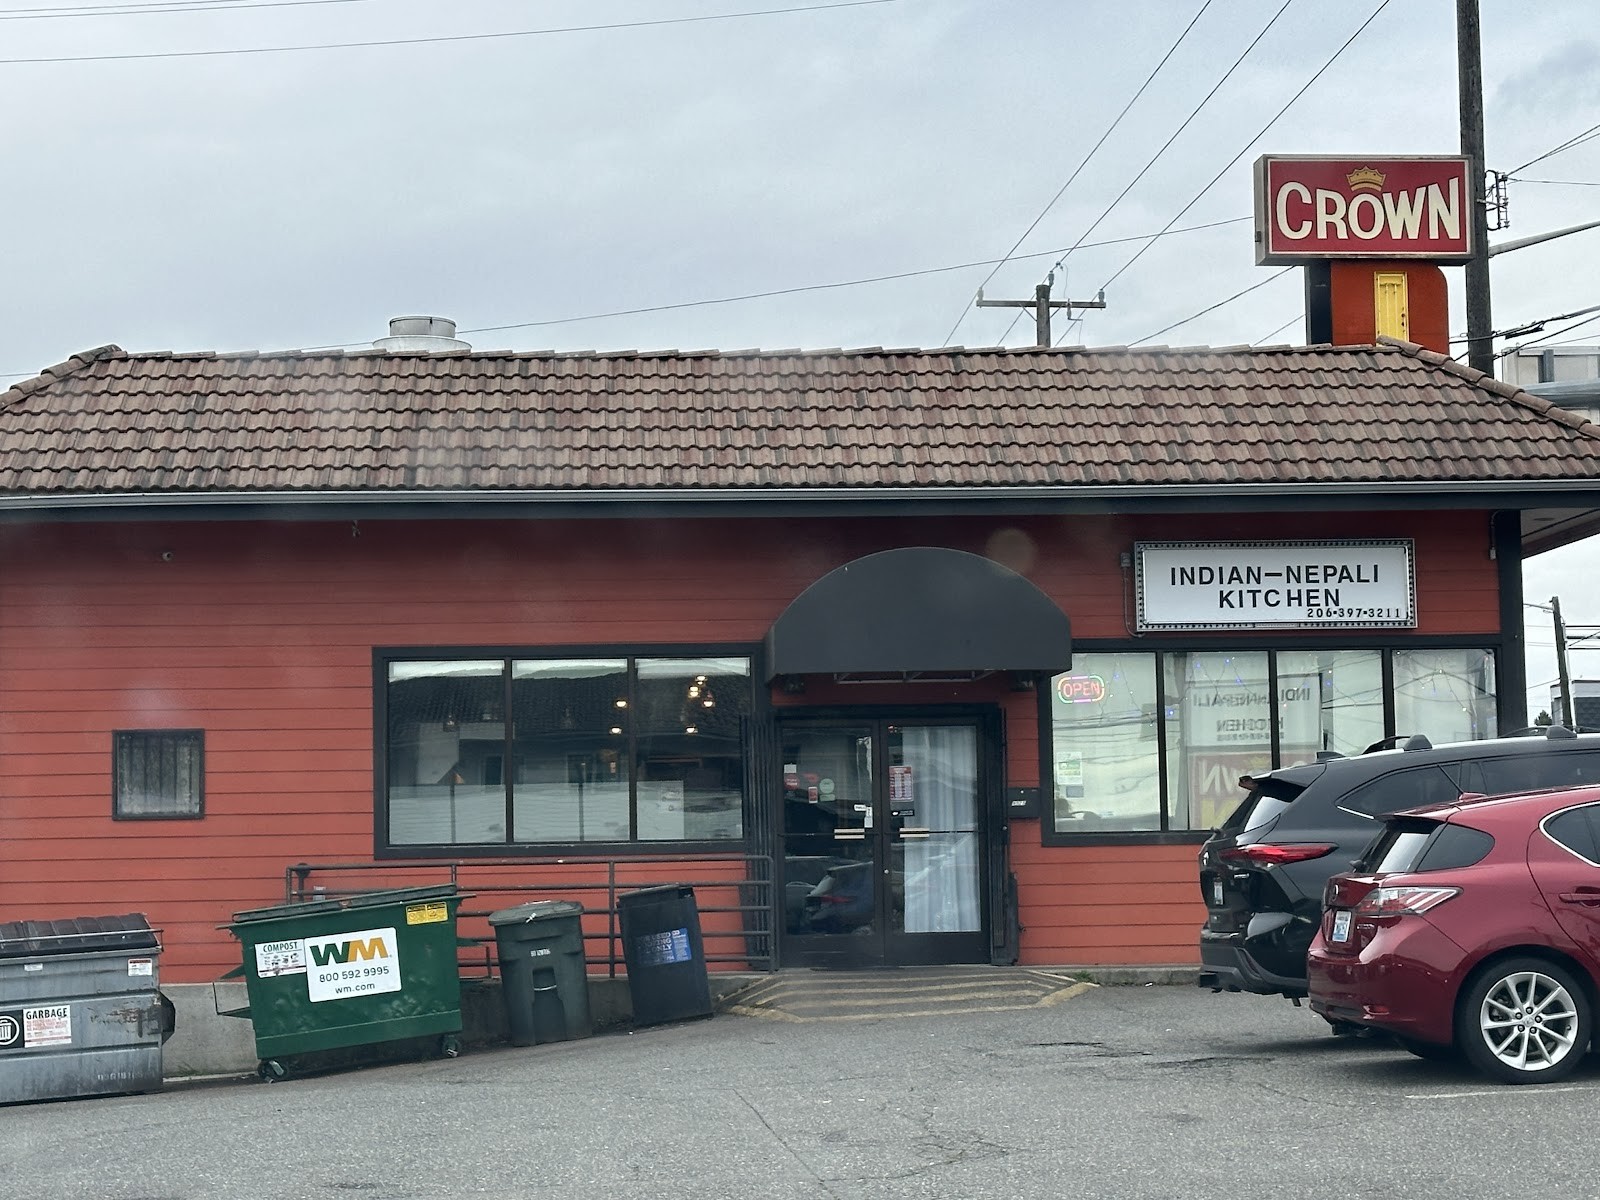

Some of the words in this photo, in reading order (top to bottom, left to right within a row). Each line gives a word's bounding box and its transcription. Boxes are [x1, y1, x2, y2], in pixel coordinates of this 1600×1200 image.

[1276, 176, 1461, 241] CROWN
[1219, 588, 1340, 608] KITCHEN
[1062, 681, 1100, 698] OPEN
[263, 941, 298, 953] COMPOST
[309, 936, 389, 967] WM
[319, 972, 340, 983] 800
[341, 969, 362, 980] 592
[363, 966, 390, 977] 9995
[335, 983, 376, 994] wm.com
[25, 1007, 68, 1020] GARBAGE
